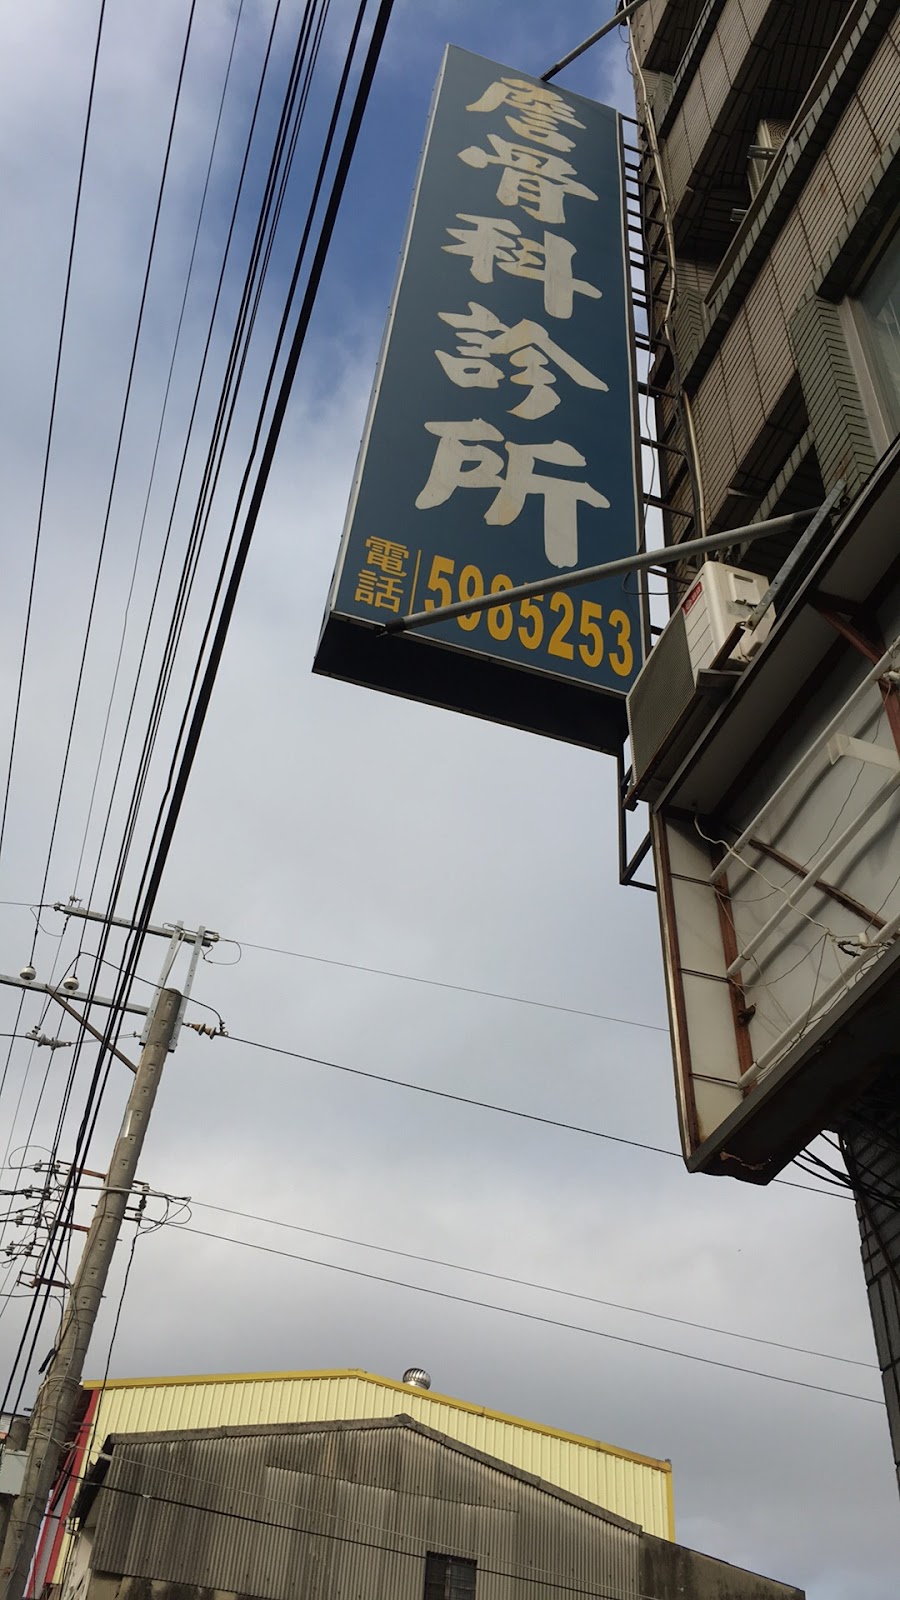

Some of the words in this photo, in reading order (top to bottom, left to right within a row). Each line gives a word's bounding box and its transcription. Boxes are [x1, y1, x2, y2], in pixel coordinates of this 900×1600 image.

[415, 77, 611, 568] 詹骨科診所
[354, 536, 409, 613] 電話
[424, 555, 634, 677] 5985253
